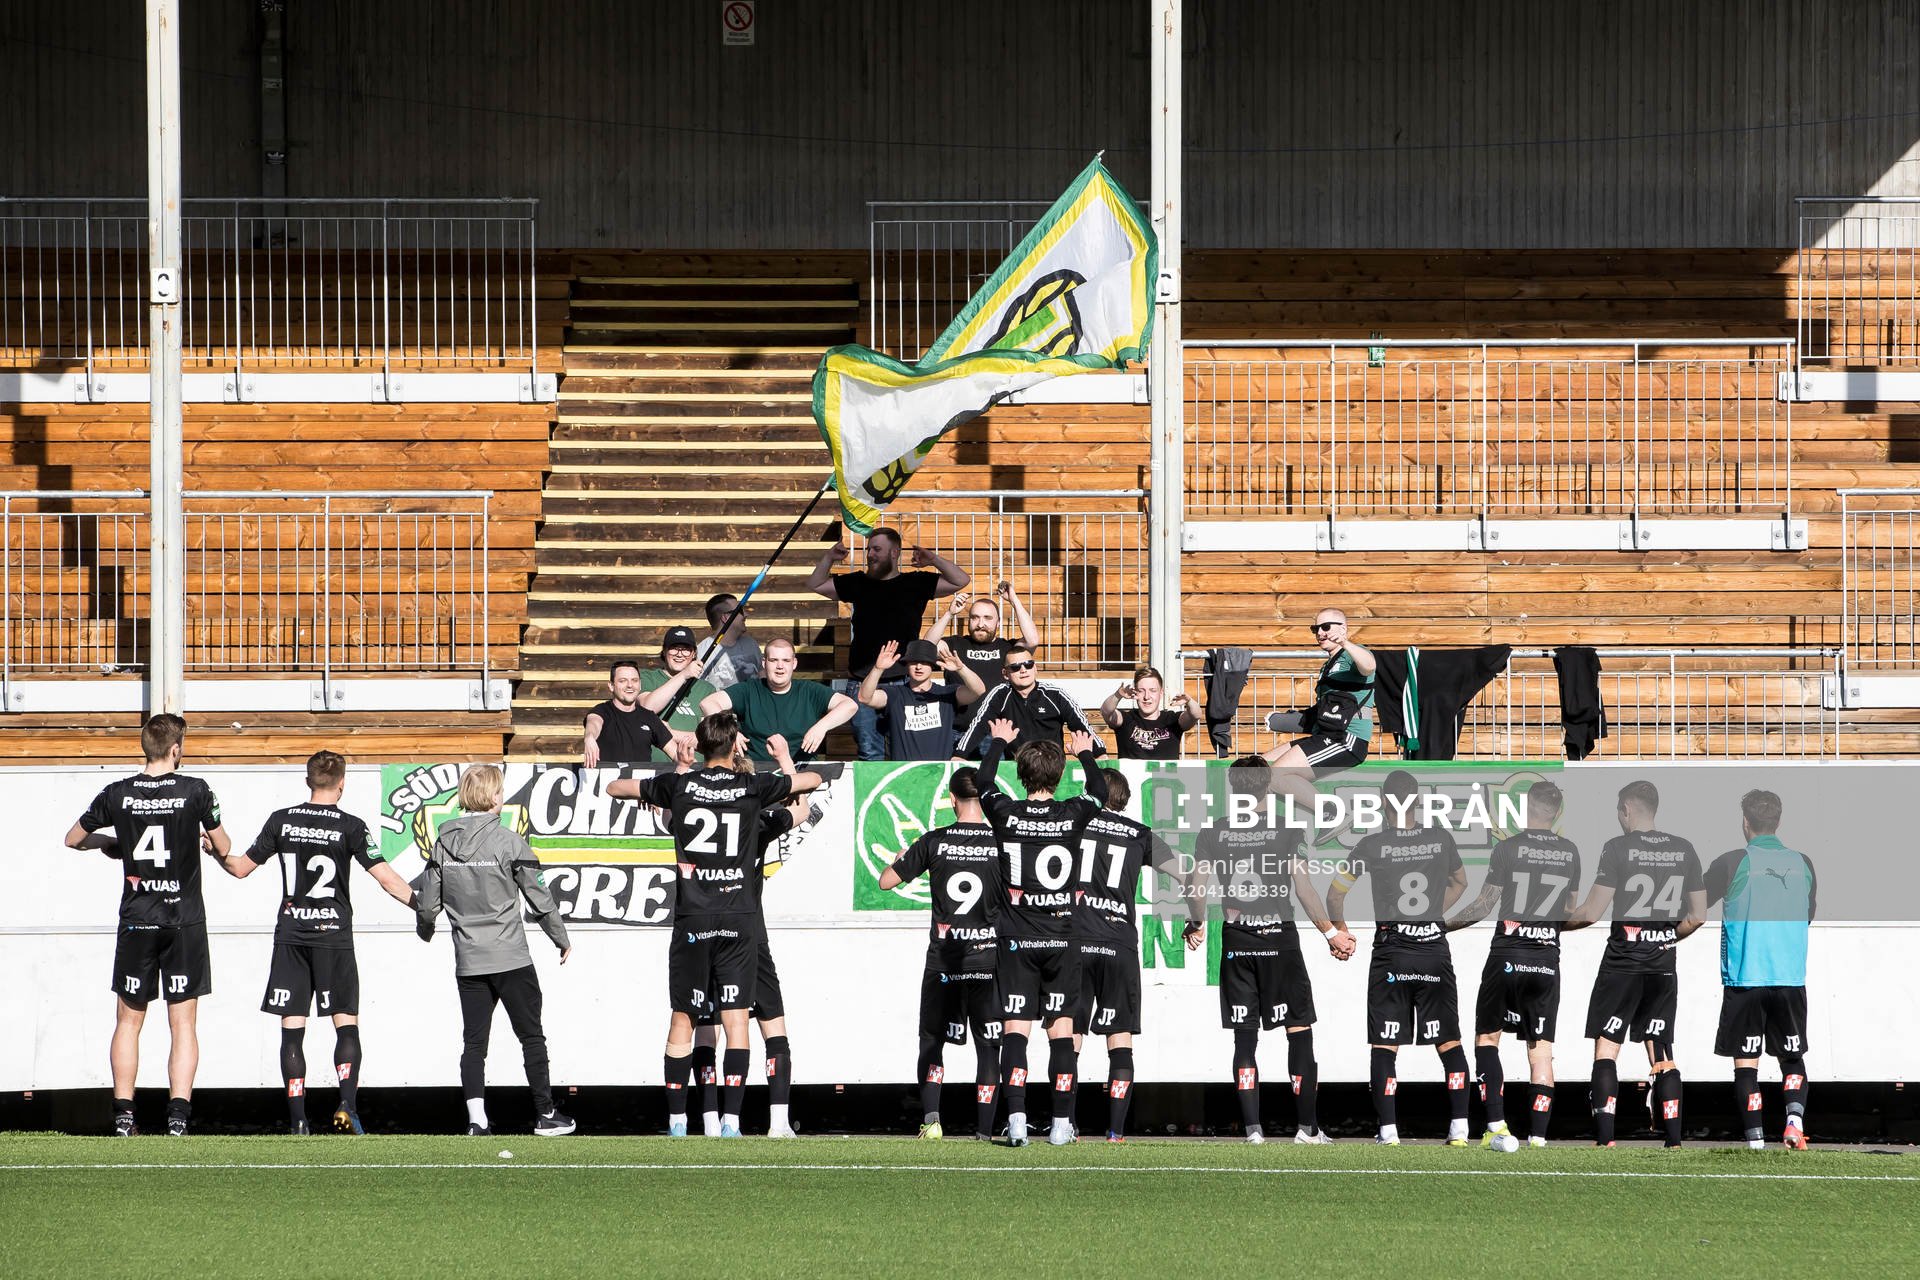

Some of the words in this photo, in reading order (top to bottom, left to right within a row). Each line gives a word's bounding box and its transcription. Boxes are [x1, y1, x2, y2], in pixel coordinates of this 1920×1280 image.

[684, 781, 747, 800] Passera
[122, 796, 186, 810] Passera
[1026, 806, 1050, 814] BOOK
[281, 824, 342, 842] Passera
[683, 807, 741, 857] 21
[1006, 815, 1074, 832] Passera
[1088, 818, 1139, 838] assera
[1396, 828, 1422, 837] BARNY
[1218, 830, 1279, 843] Passera
[132, 825, 171, 868] 4
[937, 842, 999, 857] Passera
[1381, 842, 1442, 858] Passera
[1517, 845, 1574, 862] Passera
[1628, 848, 1685, 862] Passera
[1003, 841, 1073, 891] 10
[1080, 838, 1127, 889] 11
[282, 852, 337, 899] 12
[694, 868, 745, 881] YUASA
[946, 871, 984, 916] 9
[1024, 892, 1072, 907] YUASA
[1397, 871, 1430, 917] 8
[1512, 871, 1571, 917] 17
[1623, 873, 1685, 918] 24
[291, 907, 340, 920] YUASA
[1084, 894, 1128, 915] YUASA
[1240, 913, 1283, 927] YUASA
[1397, 922, 1442, 937] YUASA
[951, 927, 998, 940] YUASA
[1518, 926, 1557, 940] YUASA
[1018, 938, 1068, 949] Vithalatvätten
[1081, 945, 1117, 957] thalatvätten
[124, 975, 141, 994] JP
[168, 975, 188, 993] JP
[269, 988, 291, 1007] JP
[320, 990, 330, 1009] J
[690, 988, 705, 1008] JP
[721, 985, 740, 1003] JP
[1046, 992, 1065, 1012] JP
[1005, 994, 1026, 1014] JP
[1231, 1004, 1248, 1023] JP
[1271, 1003, 1288, 1023] JP
[1097, 1007, 1116, 1026] JP
[1535, 1016, 1546, 1035] J
[1603, 1015, 1623, 1035] JP
[946, 1021, 965, 1040] JP
[983, 1021, 1003, 1040] JP
[1380, 1020, 1400, 1039] JP
[1424, 1020, 1440, 1039] JP
[1646, 1018, 1666, 1036] JP
[1741, 1035, 1762, 1053] JP
[1784, 1035, 1800, 1052] JP
